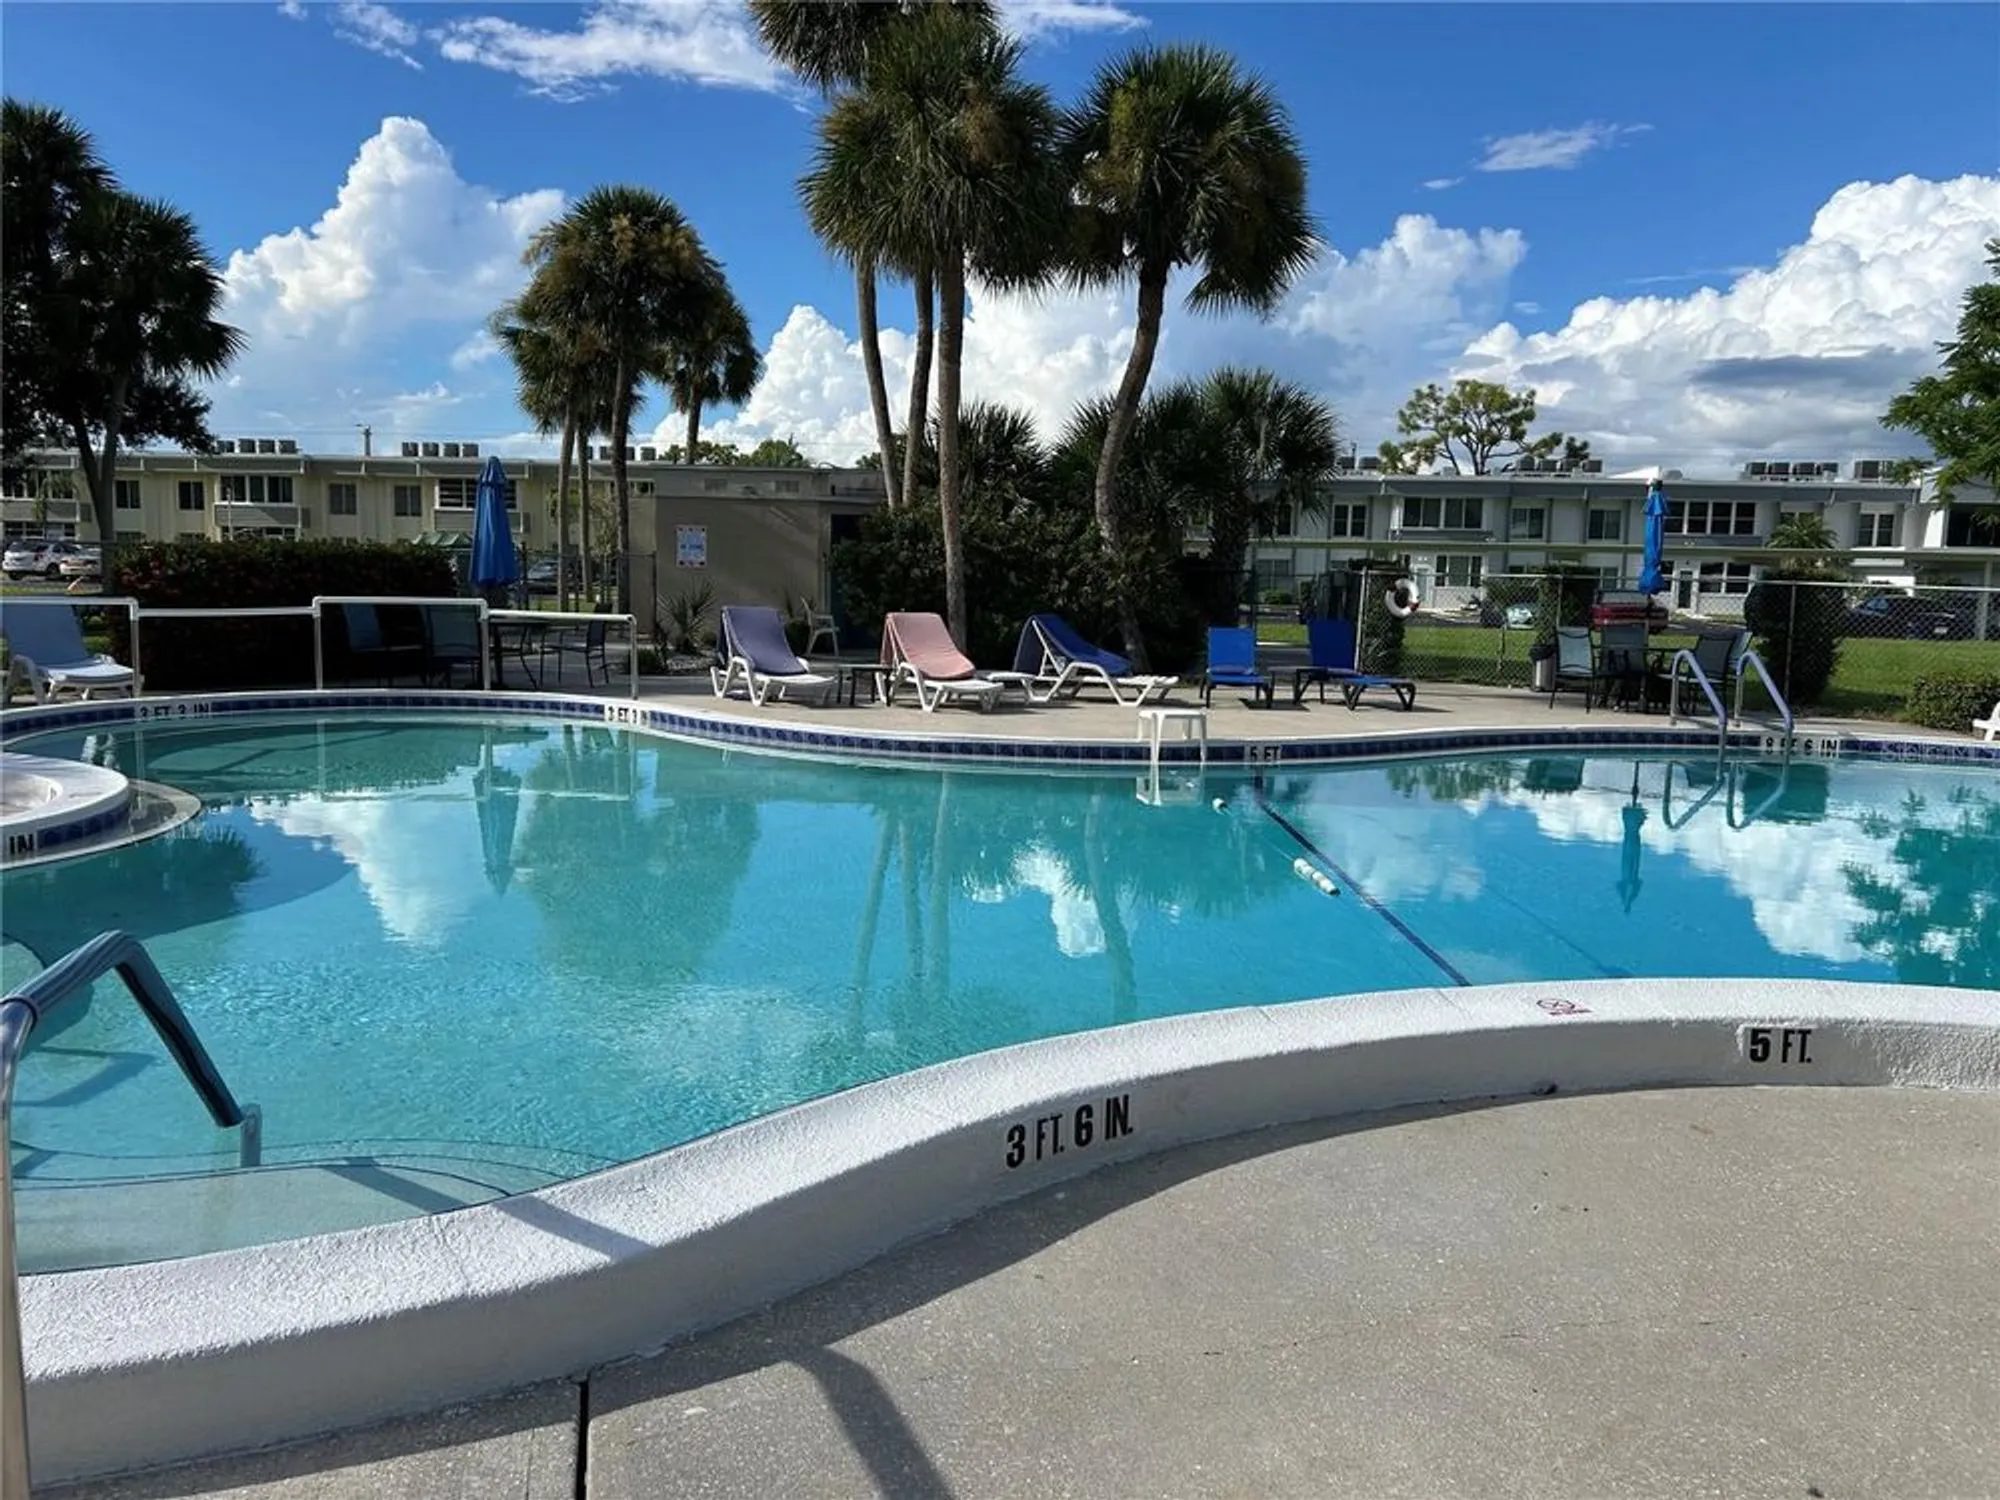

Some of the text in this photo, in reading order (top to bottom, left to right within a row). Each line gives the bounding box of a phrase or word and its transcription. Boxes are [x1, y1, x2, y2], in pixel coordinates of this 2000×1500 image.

[194, 703, 209, 714] IN
[1250, 745, 1280, 760] 5 FT
[1822, 739, 1838, 750] IN
[9, 834, 33, 855] IN
[1750, 1028, 1812, 1064] 5 FT.
[1006, 1094, 1134, 1169] 3 FT. 6 IN.
